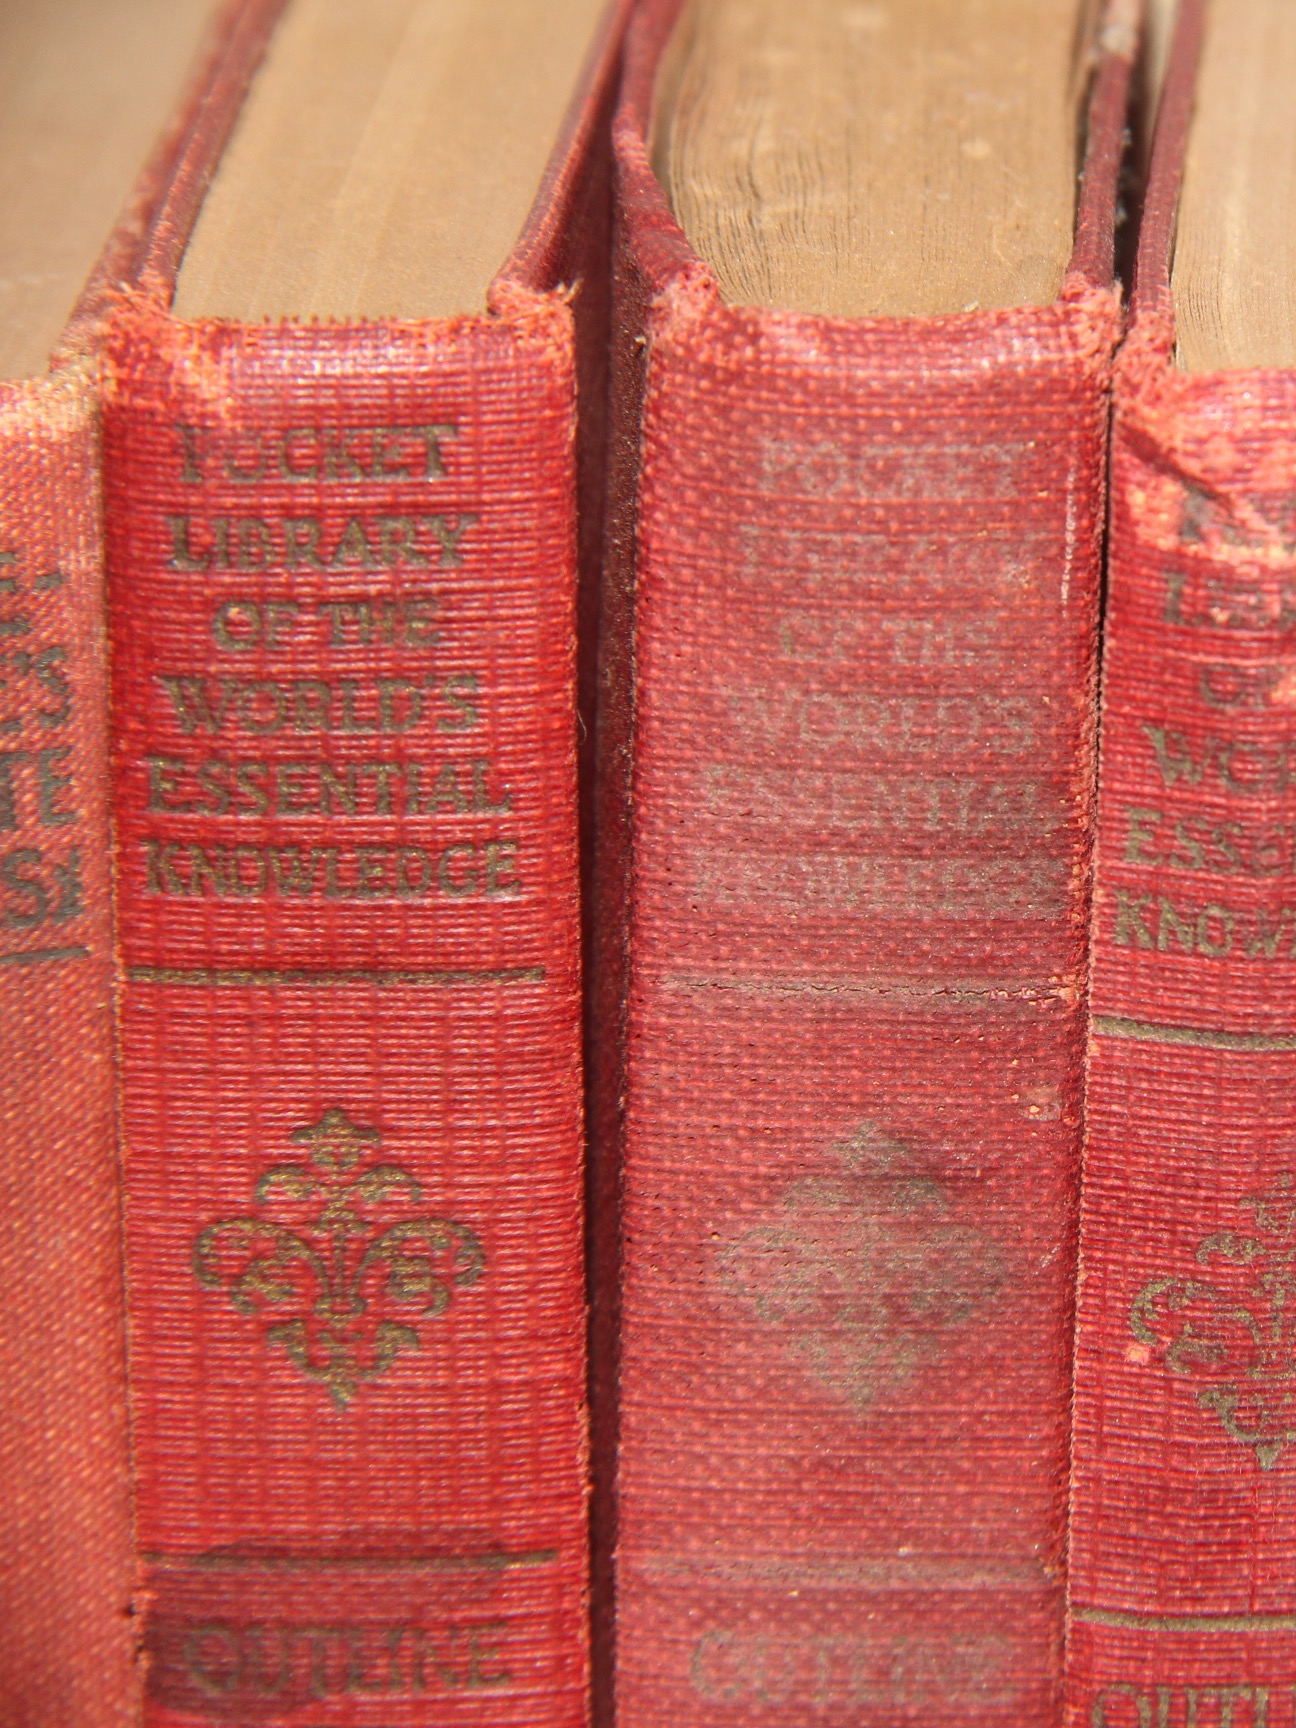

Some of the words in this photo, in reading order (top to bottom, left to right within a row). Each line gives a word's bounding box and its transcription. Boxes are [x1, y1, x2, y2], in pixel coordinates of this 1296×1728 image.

[175, 424, 458, 483] POCKET
[167, 513, 479, 571] LIBRARY
[213, 600, 299, 651] OF
[321, 599, 443, 649] THE
[157, 673, 480, 736] WORLD'S
[145, 755, 512, 817] ESSENTIAL
[143, 839, 523, 899] KNOWLEDGE
[183, 1622, 513, 1697] OUTLINE
